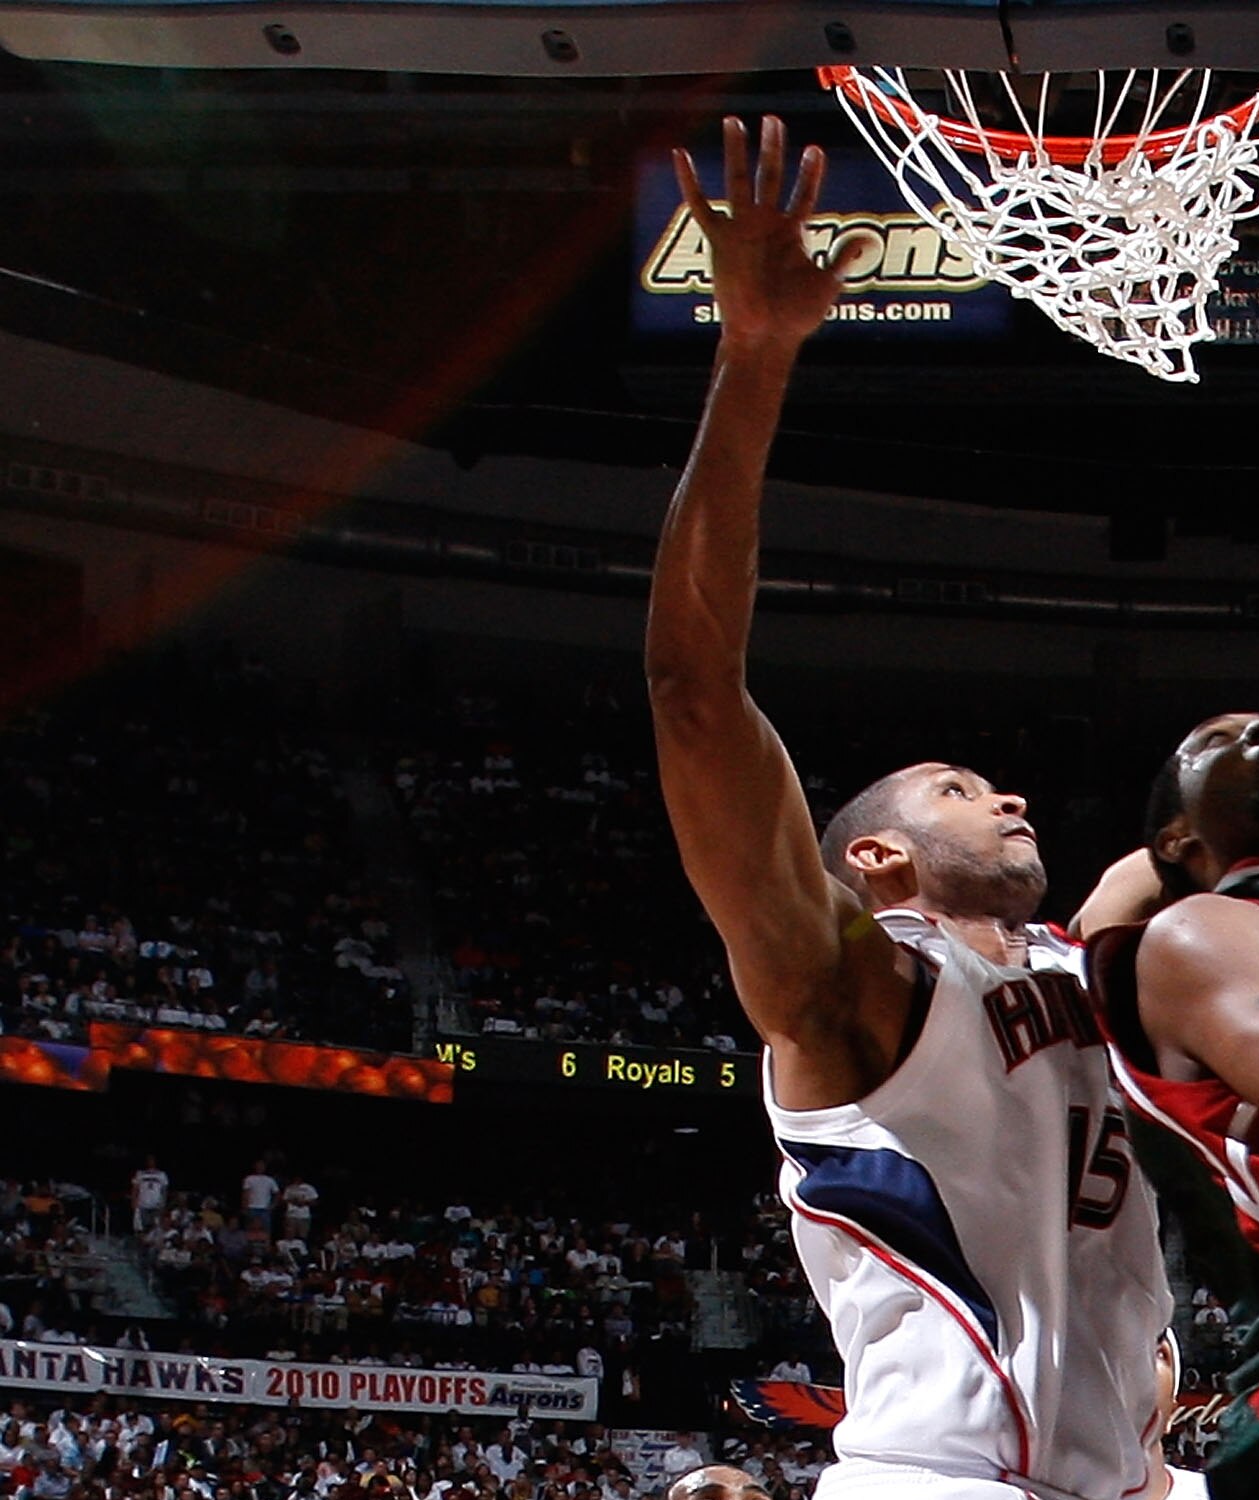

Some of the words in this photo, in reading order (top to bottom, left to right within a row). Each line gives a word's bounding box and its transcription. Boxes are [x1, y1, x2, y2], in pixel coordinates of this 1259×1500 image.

[562, 1052, 576, 1078] 6
[607, 1053, 696, 1088] Royals
[720, 1062, 735, 1088] 5
[104, 1356, 244, 1395] HAWKS
[266, 1367, 339, 1399] 2010
[350, 1372, 486, 1406] PLAYOFFS
